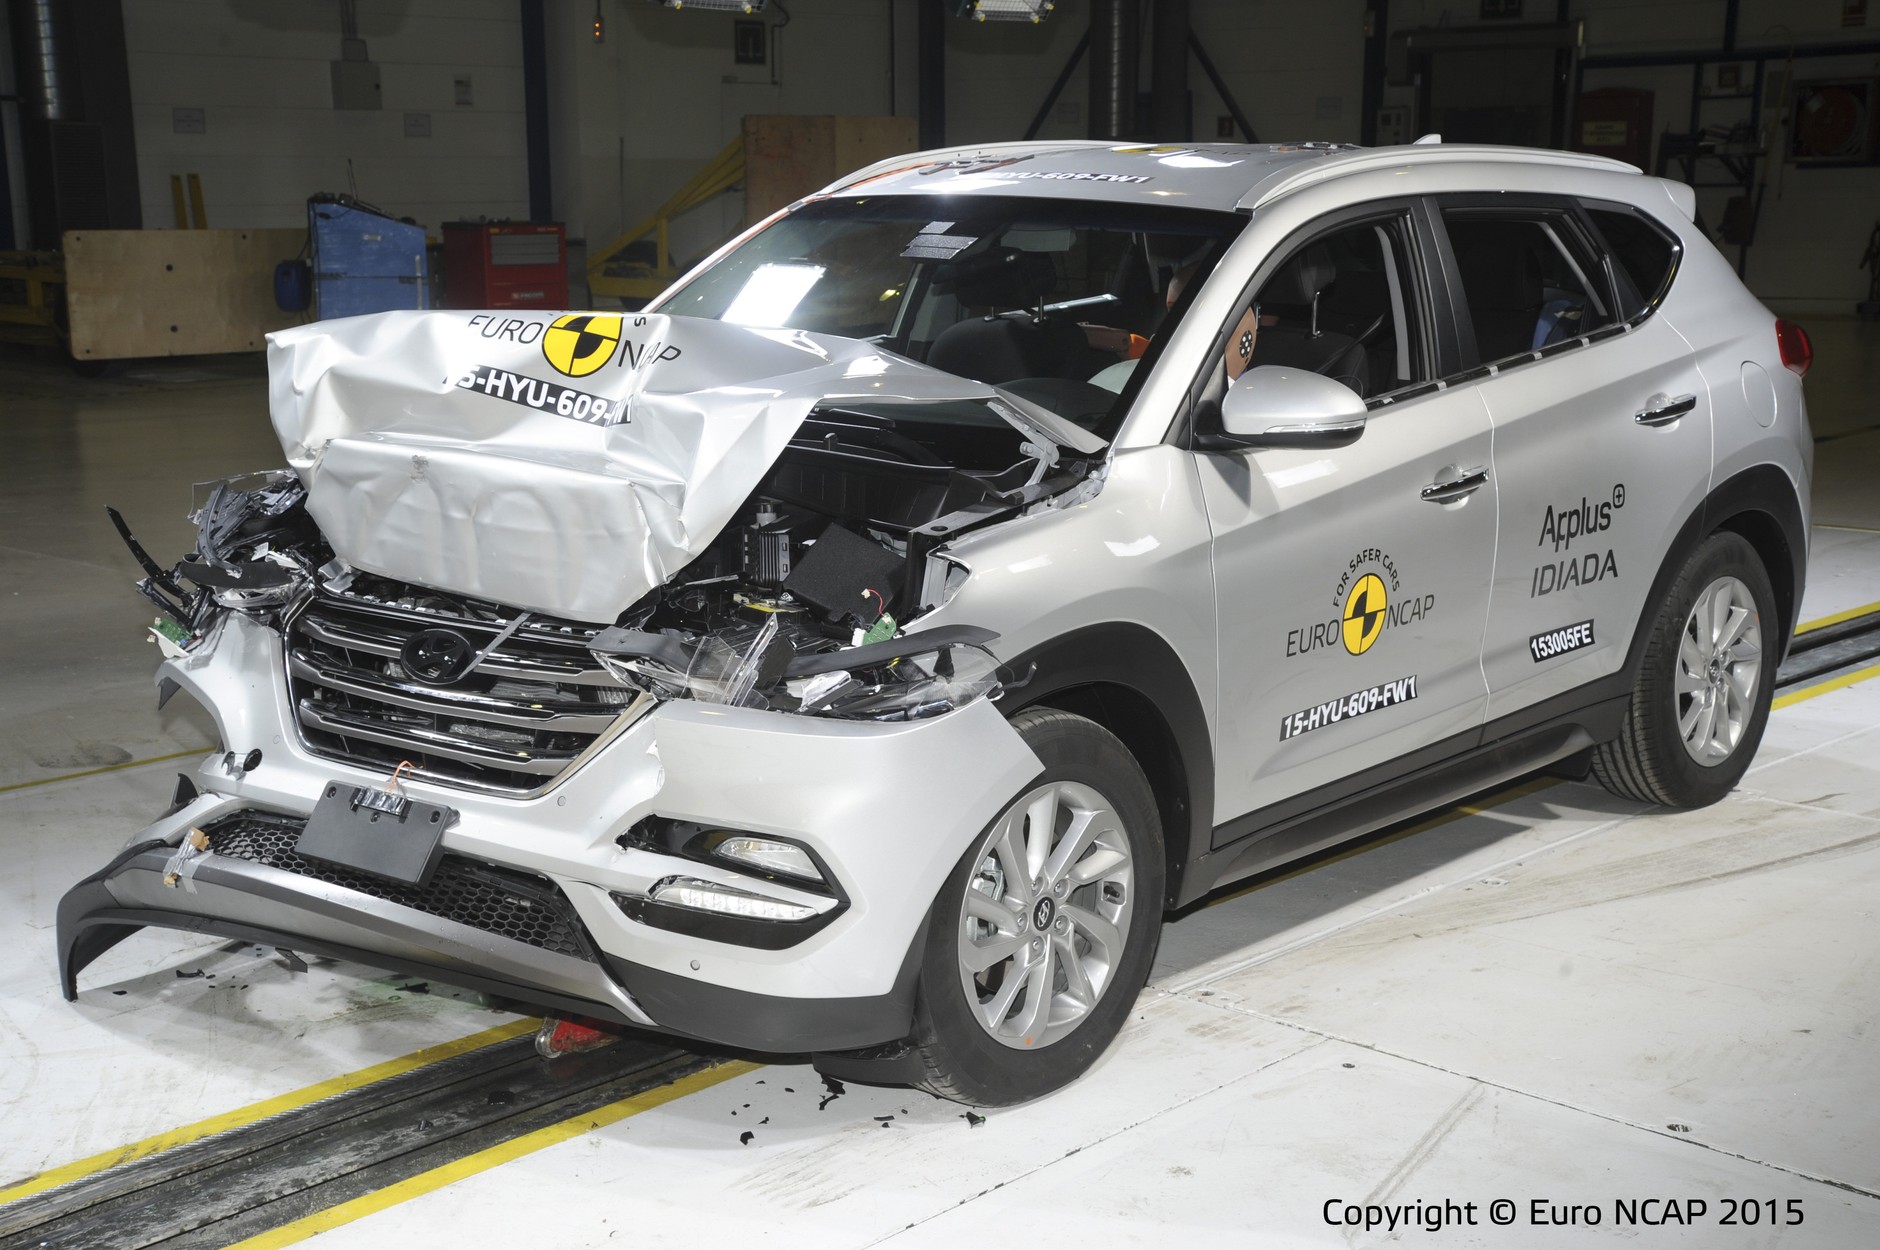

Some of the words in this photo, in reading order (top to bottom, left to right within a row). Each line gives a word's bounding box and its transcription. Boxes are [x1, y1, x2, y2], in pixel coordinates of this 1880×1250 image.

[1332, 571, 1351, 607] FOR
[1349, 548, 1381, 573] SAFER
[1382, 554, 1400, 592] CARS
[1530, 549, 1619, 599] IDIADA
[1286, 619, 1340, 658] EURO
[1386, 594, 1435, 630] NCAP
[1531, 622, 1592, 659] 153005FE
[1284, 675, 1417, 739] 15-HYU-609-FW1
